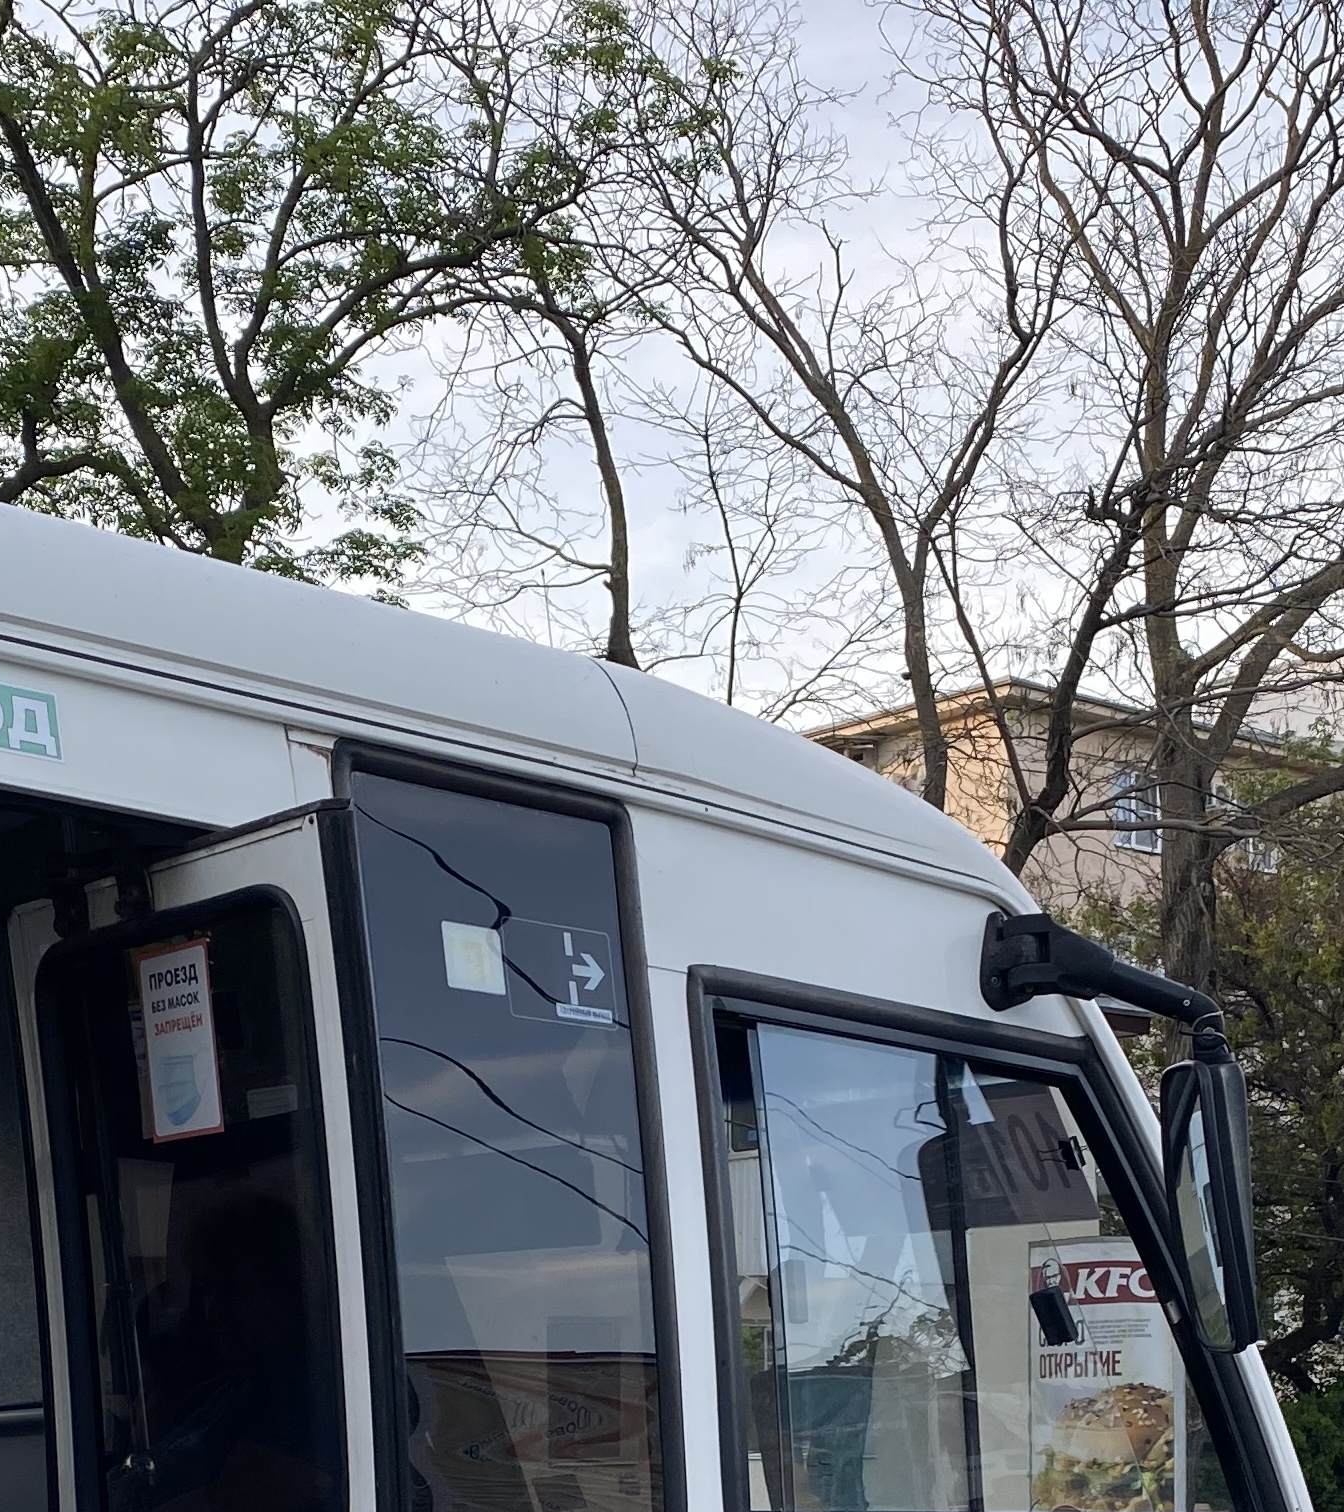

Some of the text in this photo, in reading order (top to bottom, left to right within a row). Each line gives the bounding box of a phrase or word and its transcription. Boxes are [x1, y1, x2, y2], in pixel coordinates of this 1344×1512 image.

[148, 963, 199, 991] ПРОЕЗД
[151, 991, 200, 1013] БЕЗ МАСОК
[154, 1011, 203, 1036] ЗАПРЕЩЁН
[1073, 1266, 1156, 1299] KFC
[1039, 1349, 1123, 1379] ОТКРЫТИЕ
